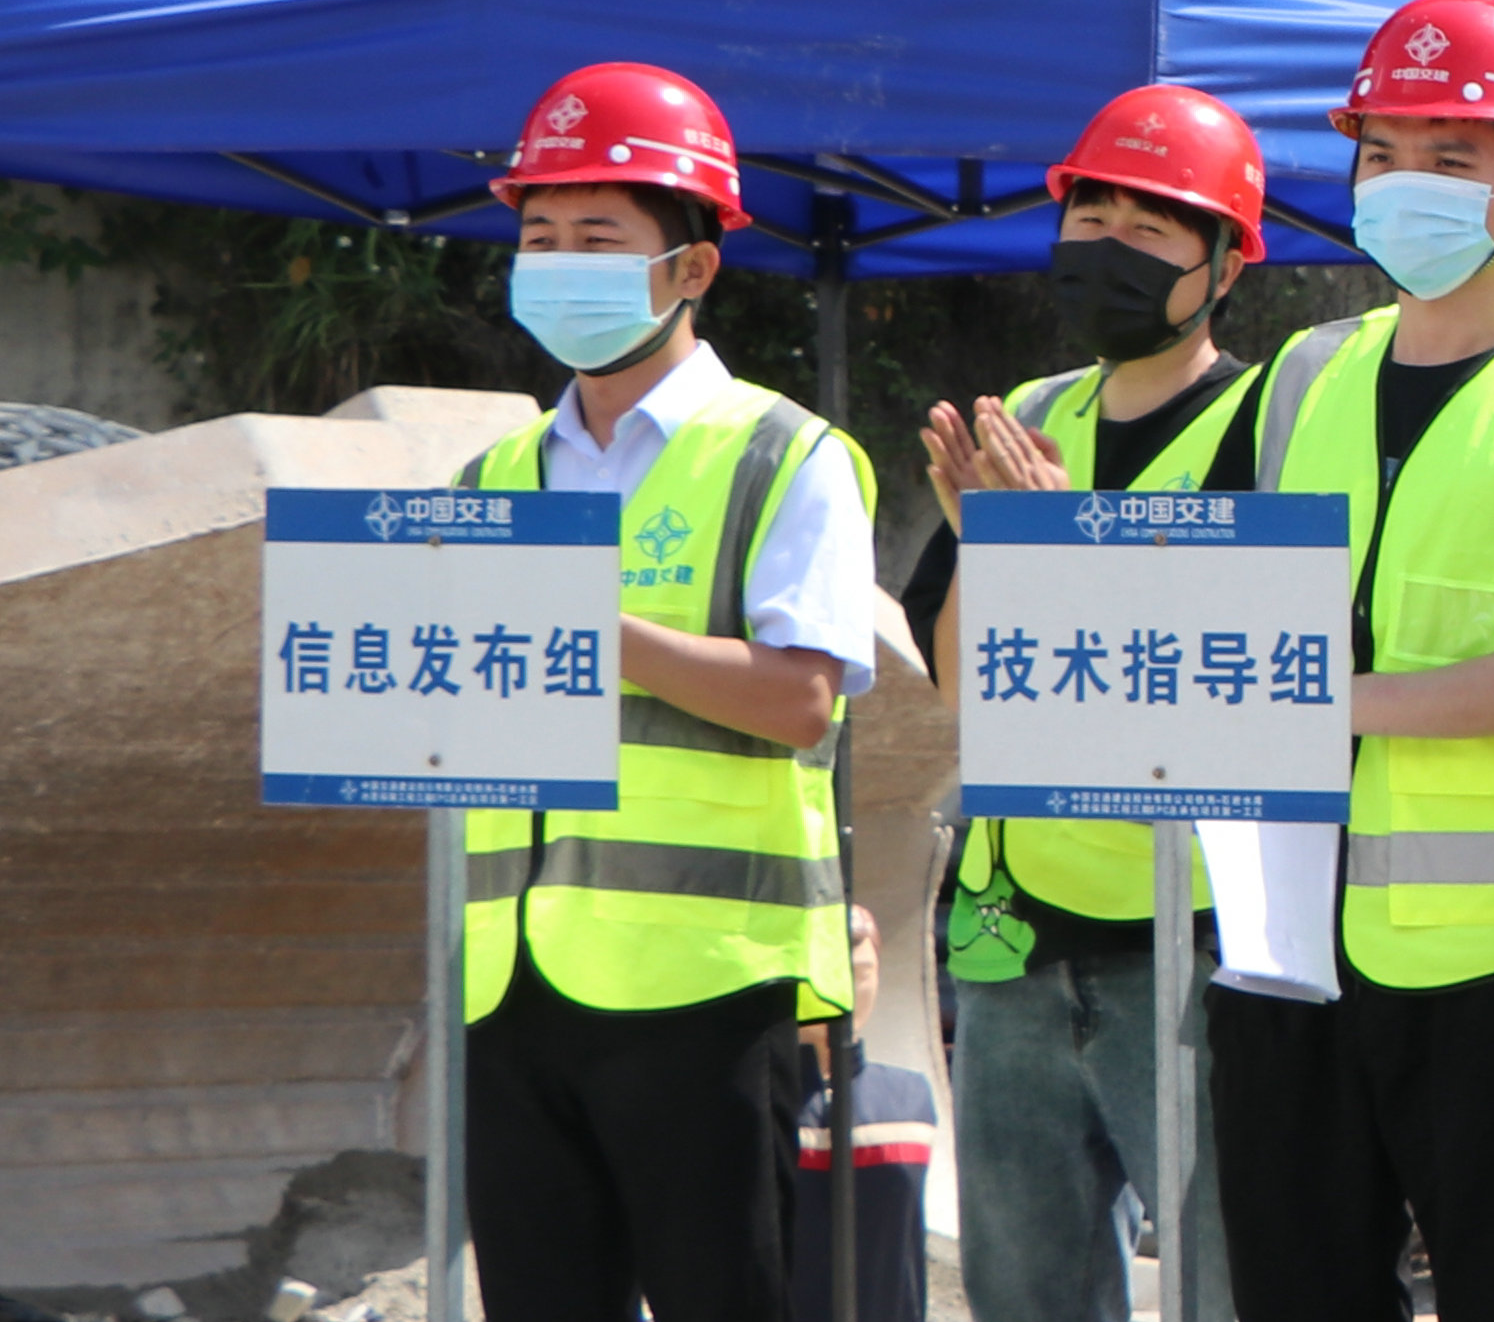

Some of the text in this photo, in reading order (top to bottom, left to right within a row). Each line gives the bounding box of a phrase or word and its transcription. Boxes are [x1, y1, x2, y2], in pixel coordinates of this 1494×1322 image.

[405, 496, 512, 524] 中国交建
[1119, 496, 1235, 525] 中国交建
[279, 621, 604, 699] 信息发布组
[977, 627, 1334, 705] 技术指导组
